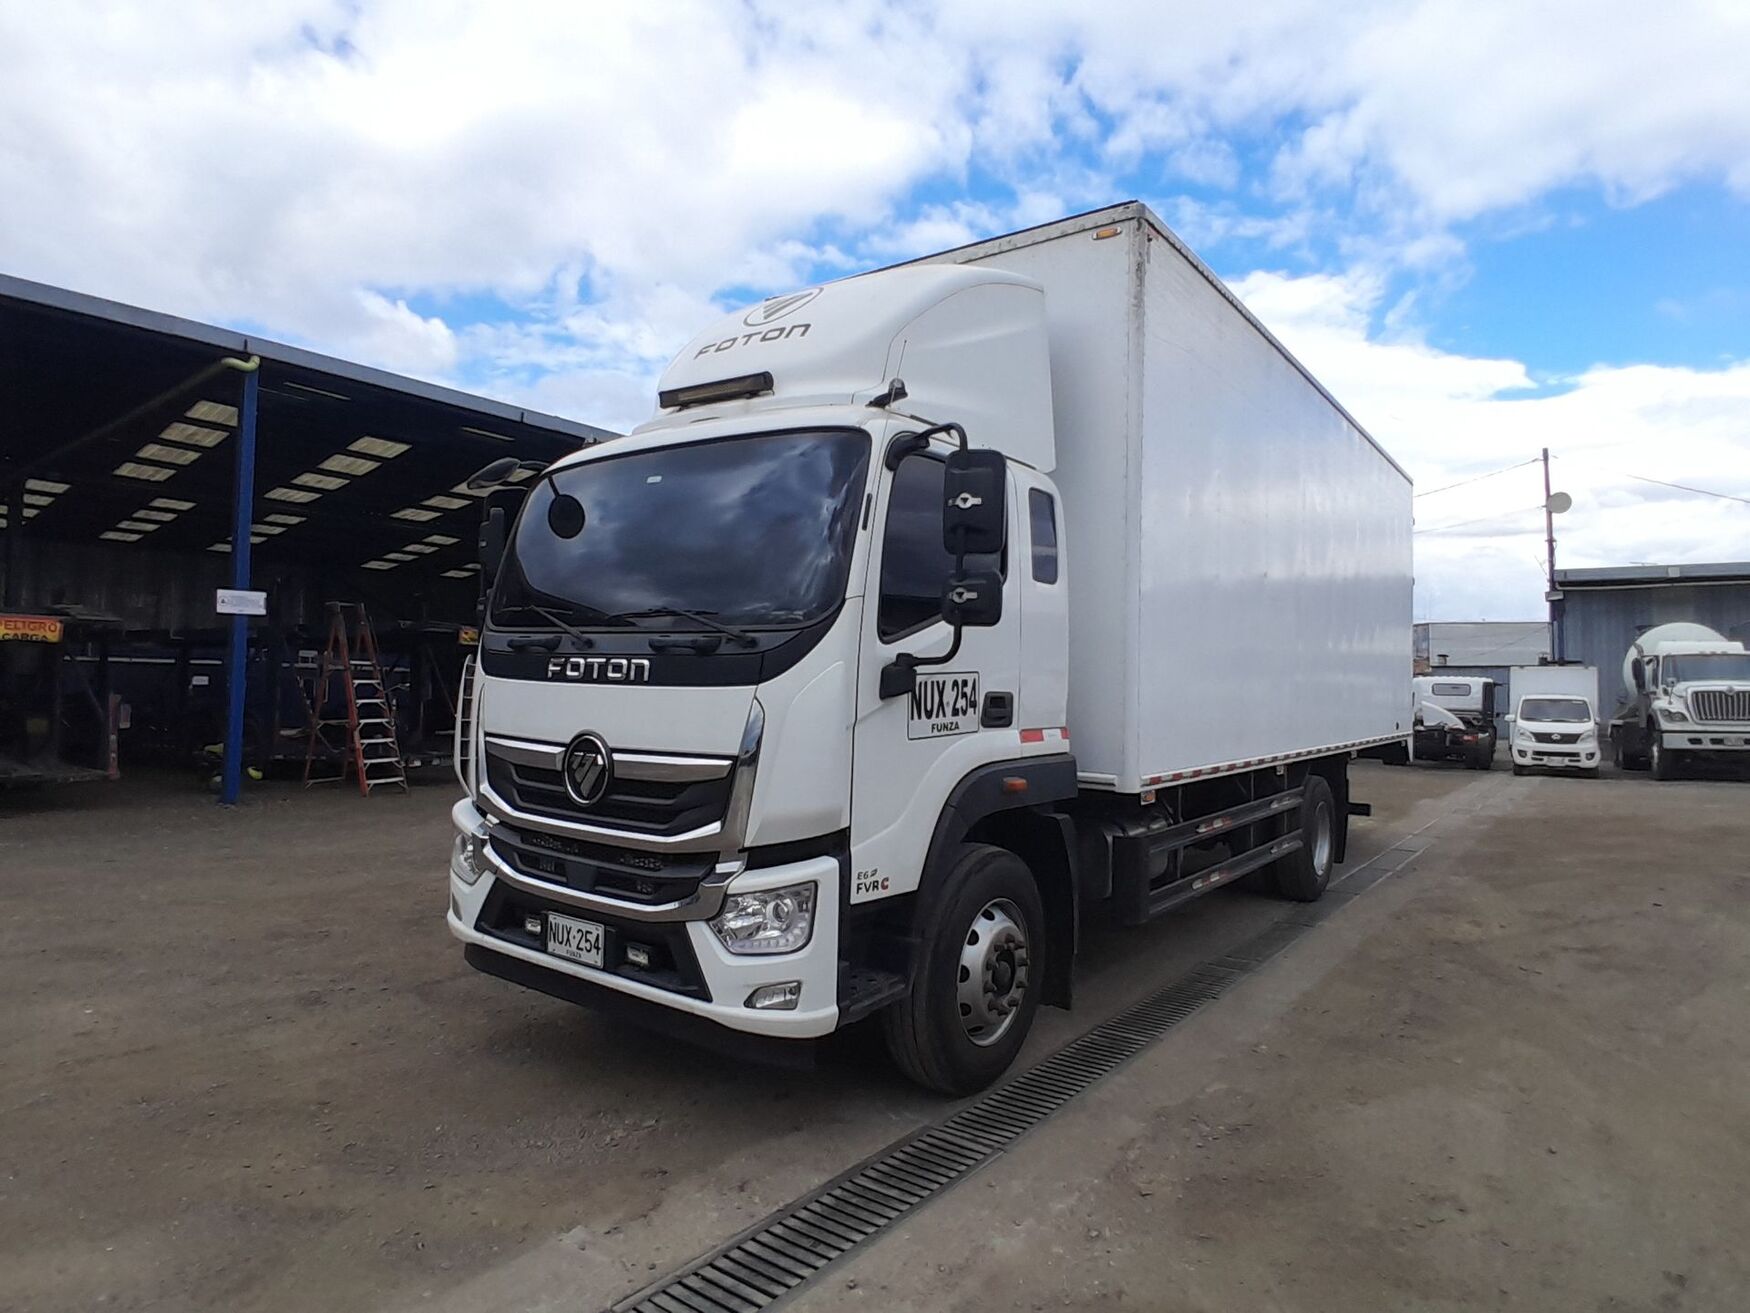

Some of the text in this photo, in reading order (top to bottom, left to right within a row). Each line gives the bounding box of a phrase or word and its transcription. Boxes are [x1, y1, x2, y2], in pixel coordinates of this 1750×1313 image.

[694, 323, 811, 360] FOTON
[547, 658, 650, 681] FOTON
[931, 721, 960, 733] FUNZA
